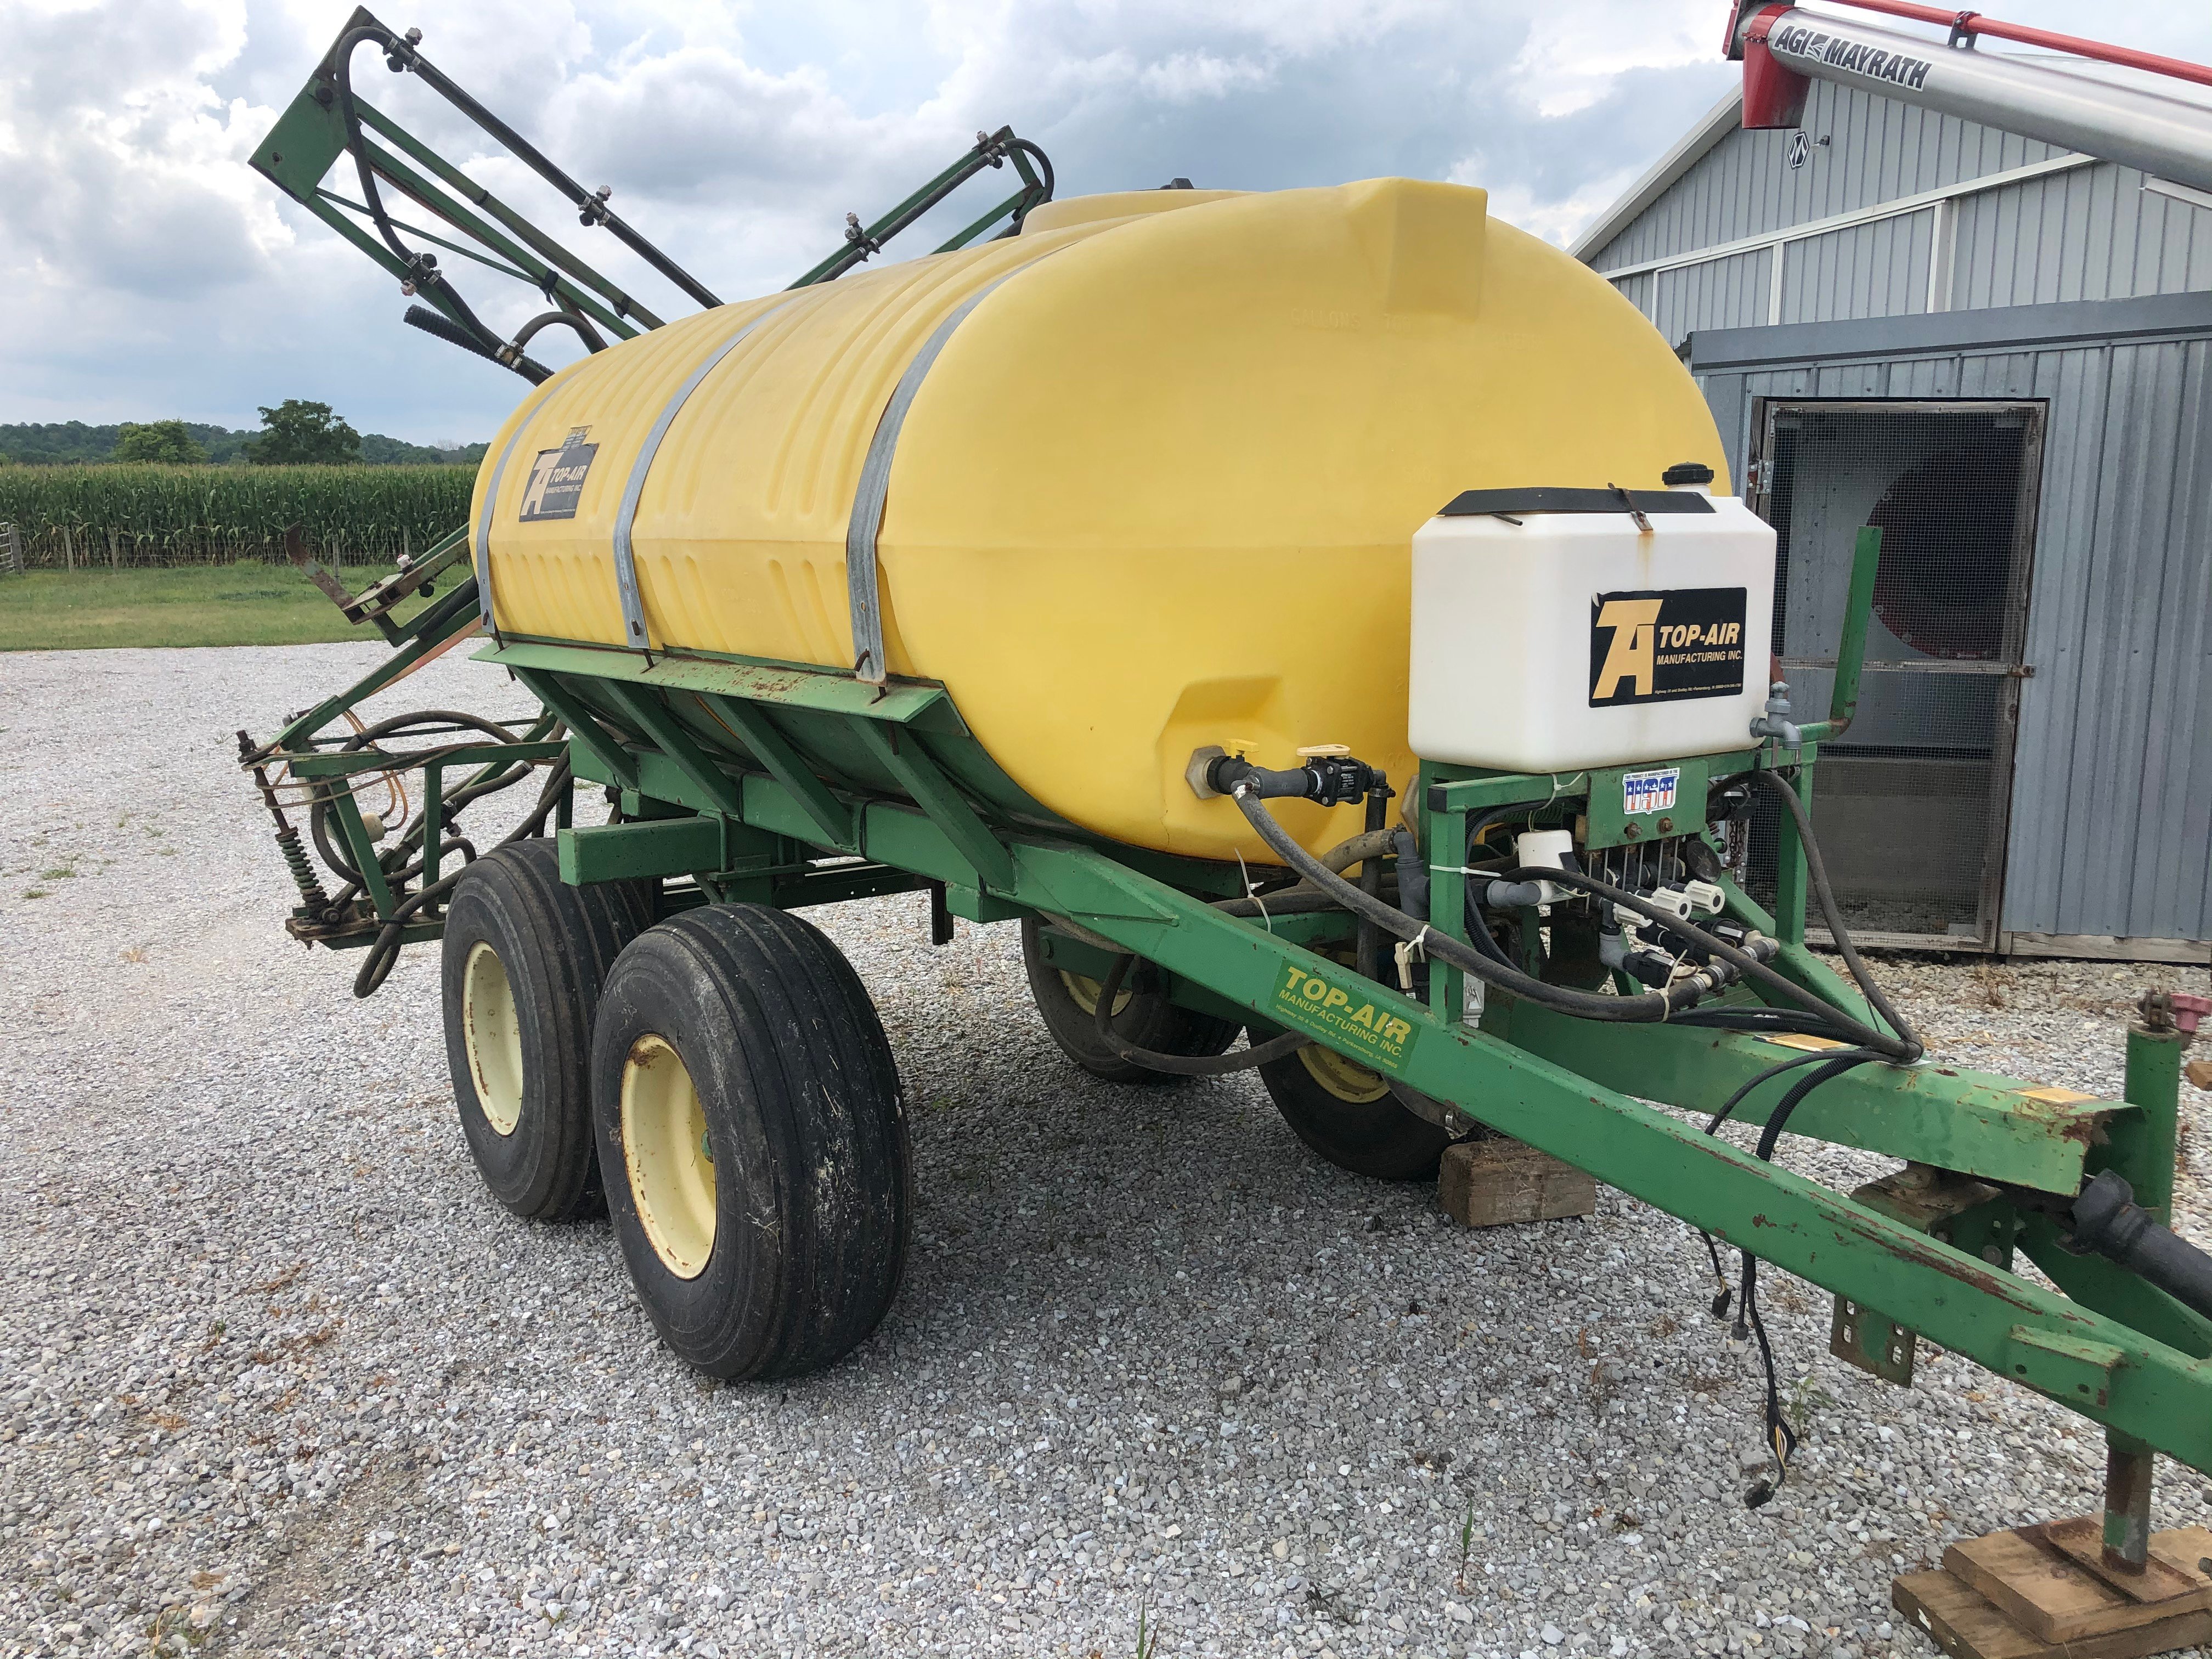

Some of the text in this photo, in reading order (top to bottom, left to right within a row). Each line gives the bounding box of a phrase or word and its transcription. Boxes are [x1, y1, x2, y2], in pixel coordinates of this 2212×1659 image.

[1775, 26, 1932, 89] AGI MAYRATH
[550, 465, 587, 483] TOP-AIR
[1660, 623, 1740, 648] TOP-AIR
[1656, 650, 1742, 665] MANUFACTURING INC.
[1625, 776, 1677, 811] USA
[1286, 966, 1411, 1045] TOP-AIR
[1279, 989, 1402, 1058] MANUFACTURING INC.
[1310, 1021, 1328, 1034] Dudley
